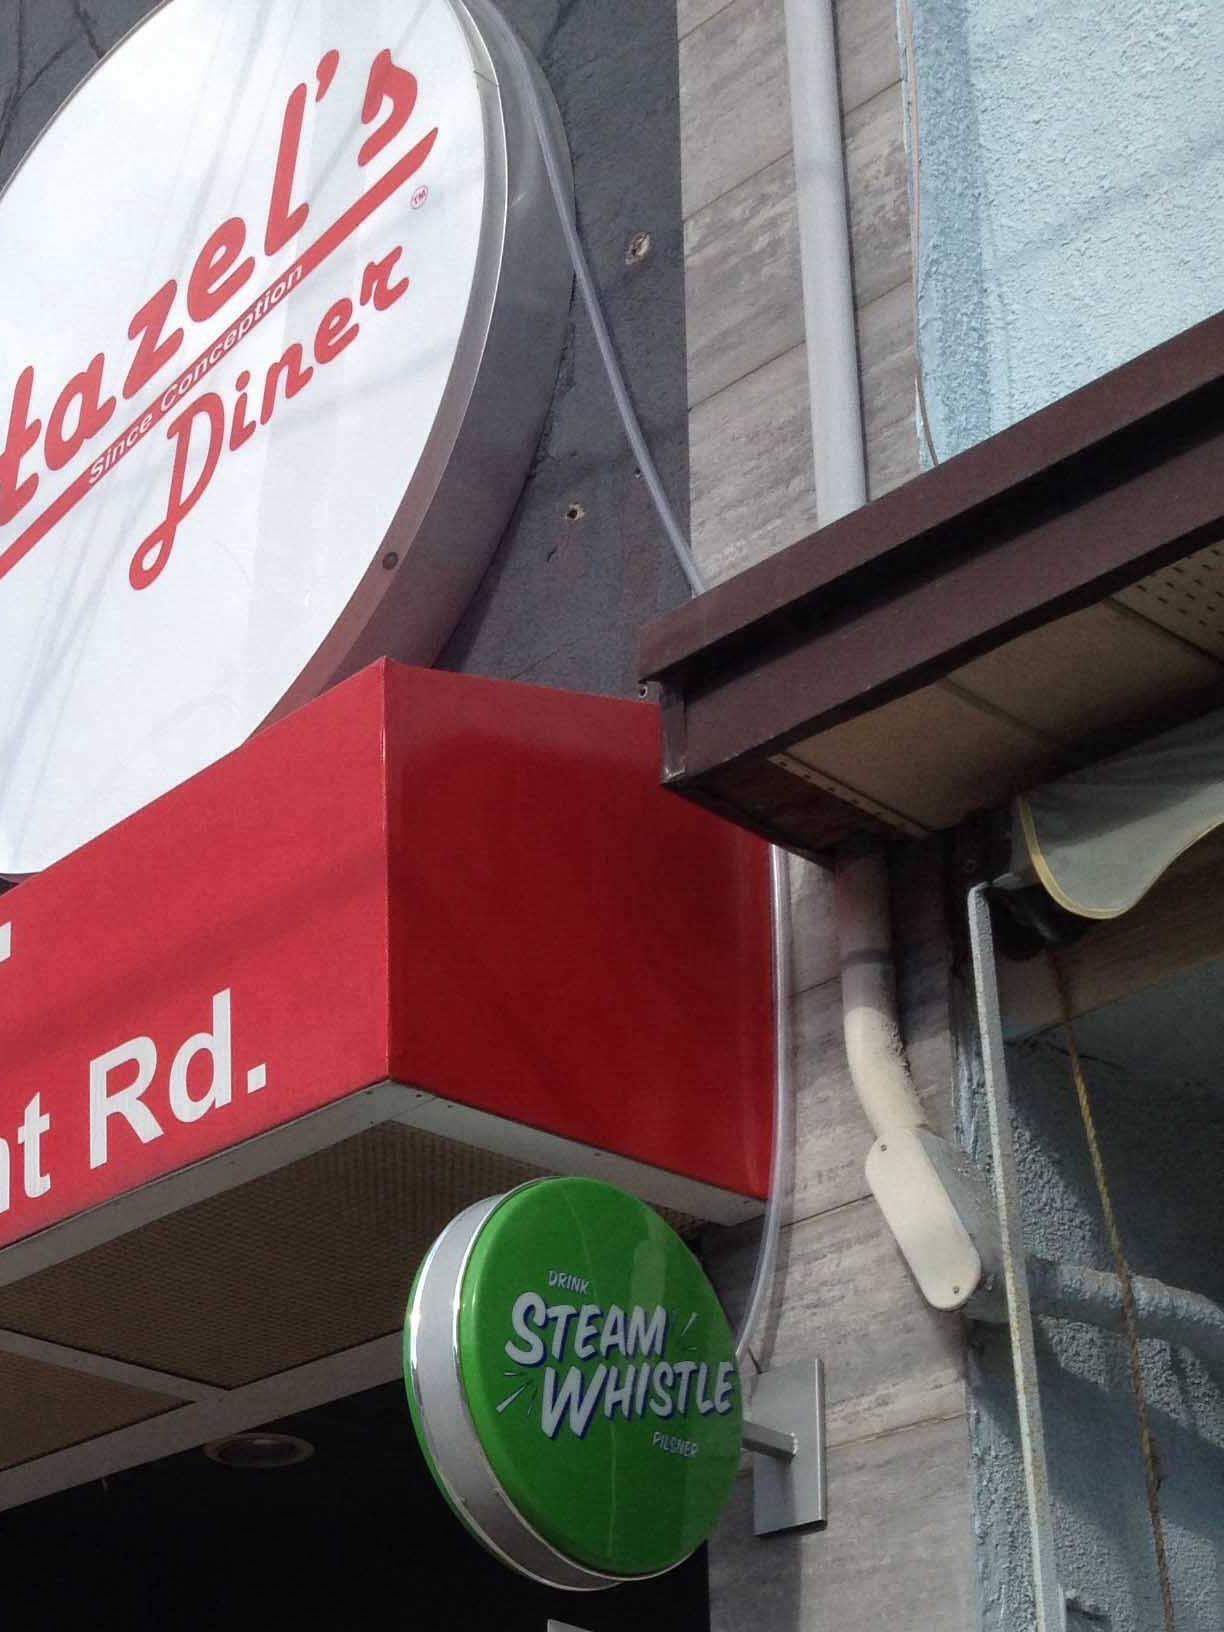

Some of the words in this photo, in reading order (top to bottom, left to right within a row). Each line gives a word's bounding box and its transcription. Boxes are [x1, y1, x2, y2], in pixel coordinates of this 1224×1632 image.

[88, 413, 153, 486] Since
[160, 265, 303, 412] Conception
[128, 246, 410, 592] Diner
[89, 987, 267, 1170] Rd.
[504, 1291, 668, 1367] STEAM
[548, 1270, 590, 1295] DRINK
[541, 1360, 735, 1440] WHISTLE
